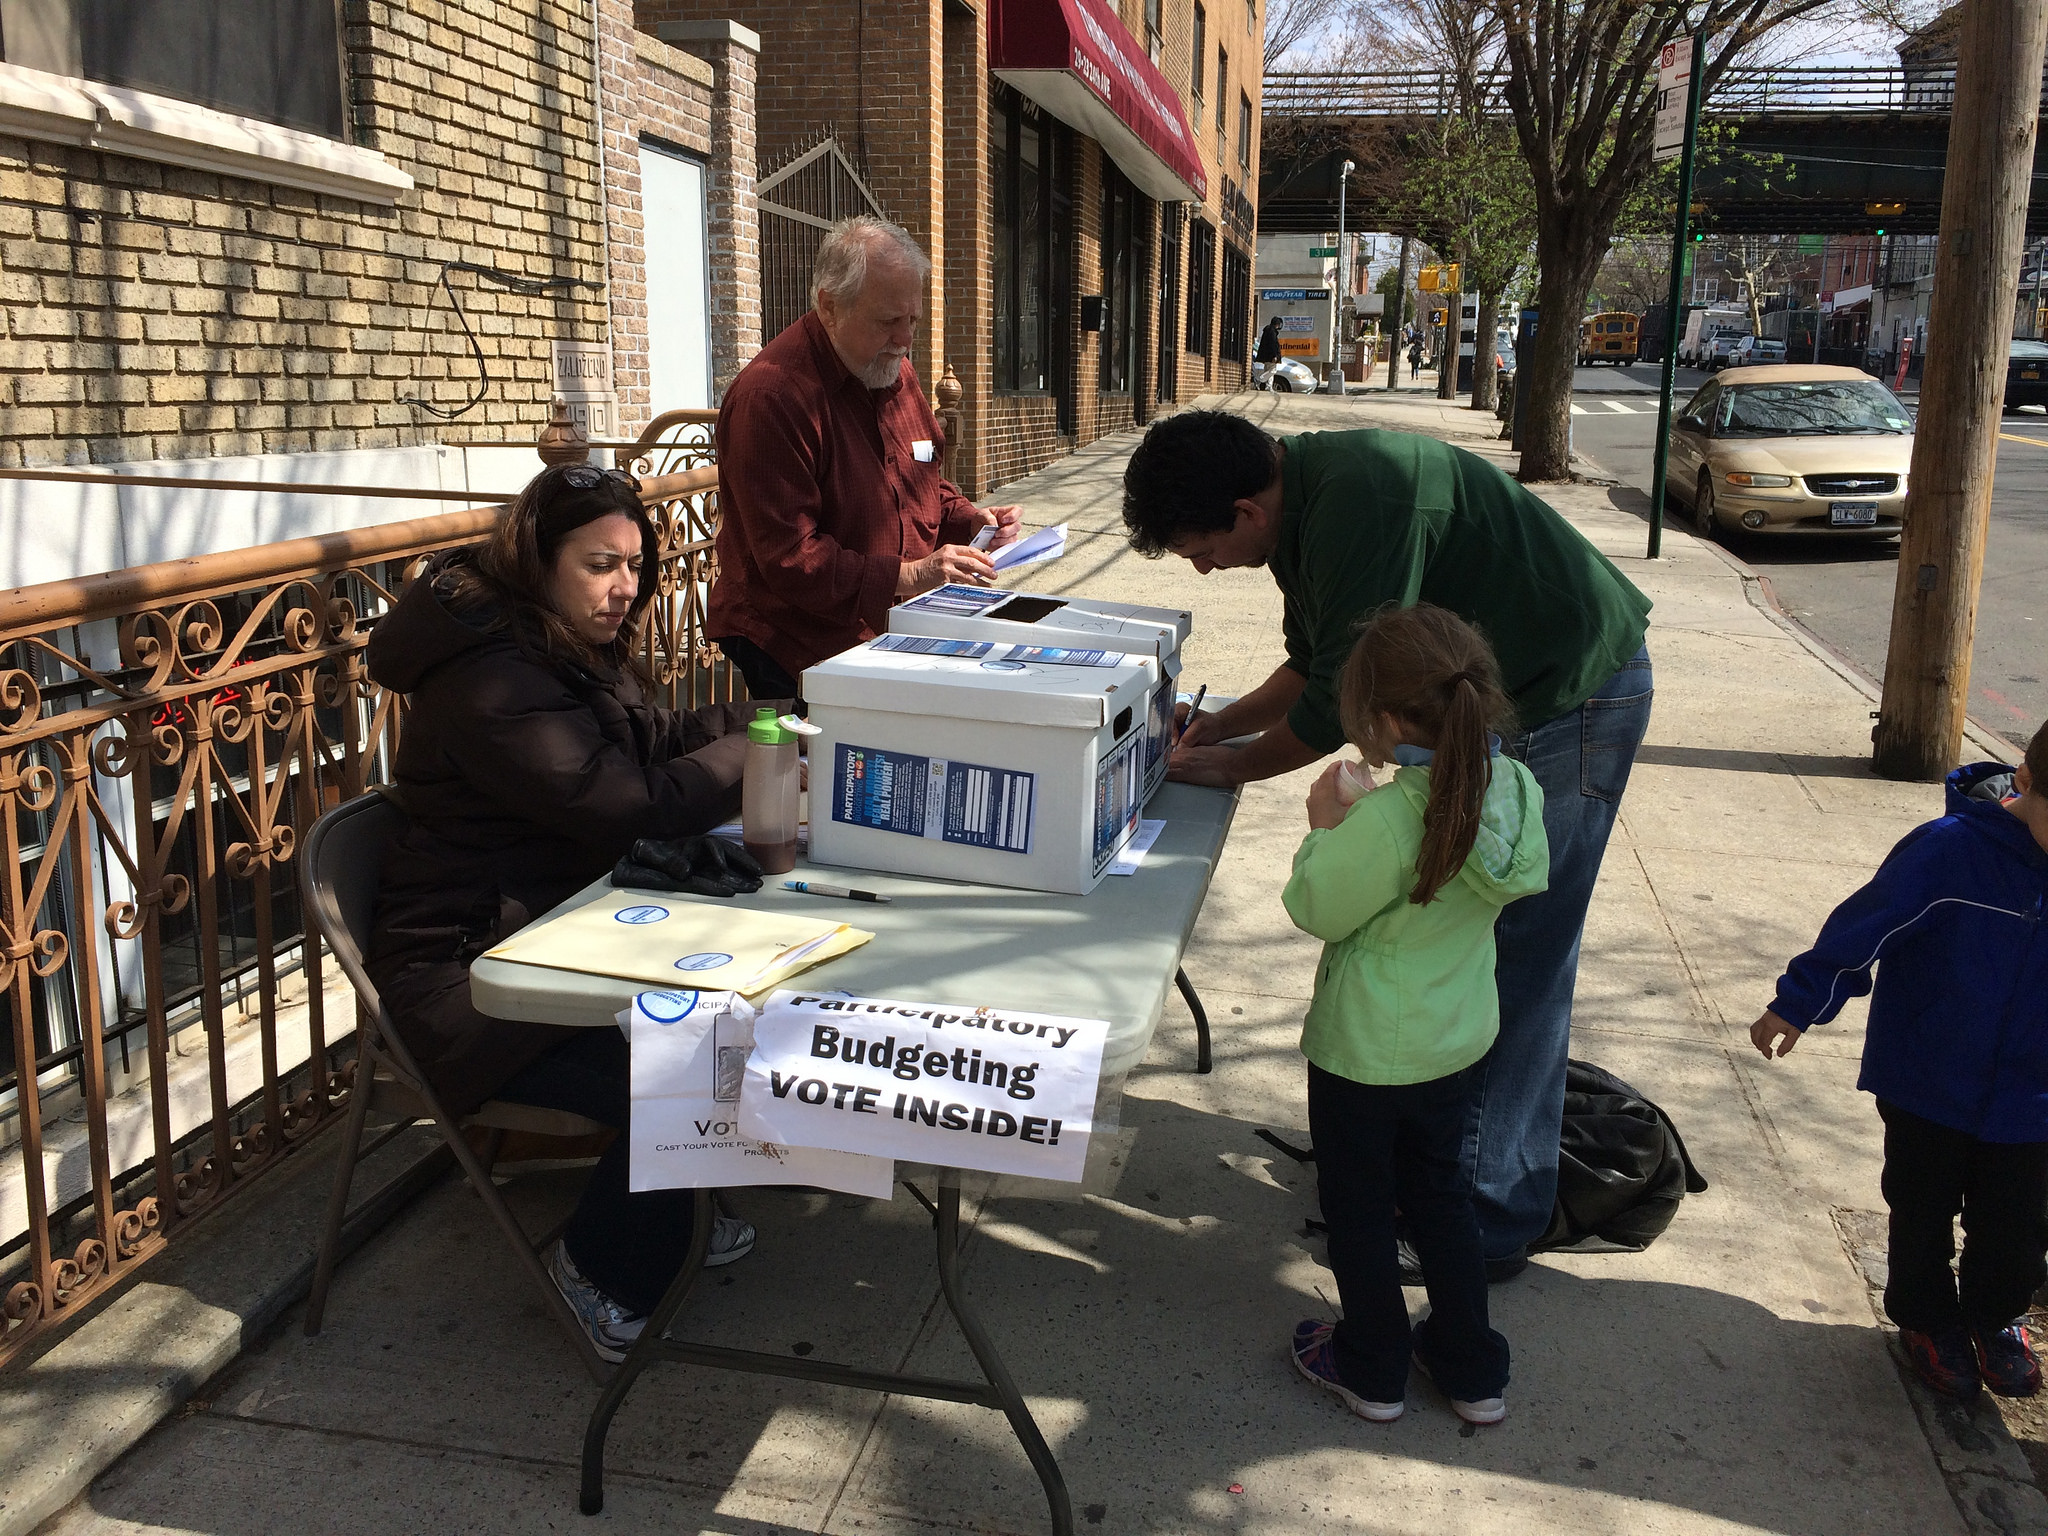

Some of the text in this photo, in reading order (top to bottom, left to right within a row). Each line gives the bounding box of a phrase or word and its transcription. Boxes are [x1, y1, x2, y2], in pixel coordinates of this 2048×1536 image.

[1660, 91, 1665, 110] 1
[844, 749, 856, 820] PARTICIPATORY
[855, 779, 863, 821] BUDGETING
[874, 754, 885, 802] PROJECTS!
[880, 762, 893, 820] REAL POWER!
[789, 996, 1079, 1048] Participatory
[810, 1024, 1039, 1101] Budgeting
[693, 1120, 738, 1137] VOT
[770, 1070, 1064, 1146] VOTE INSIDE!
